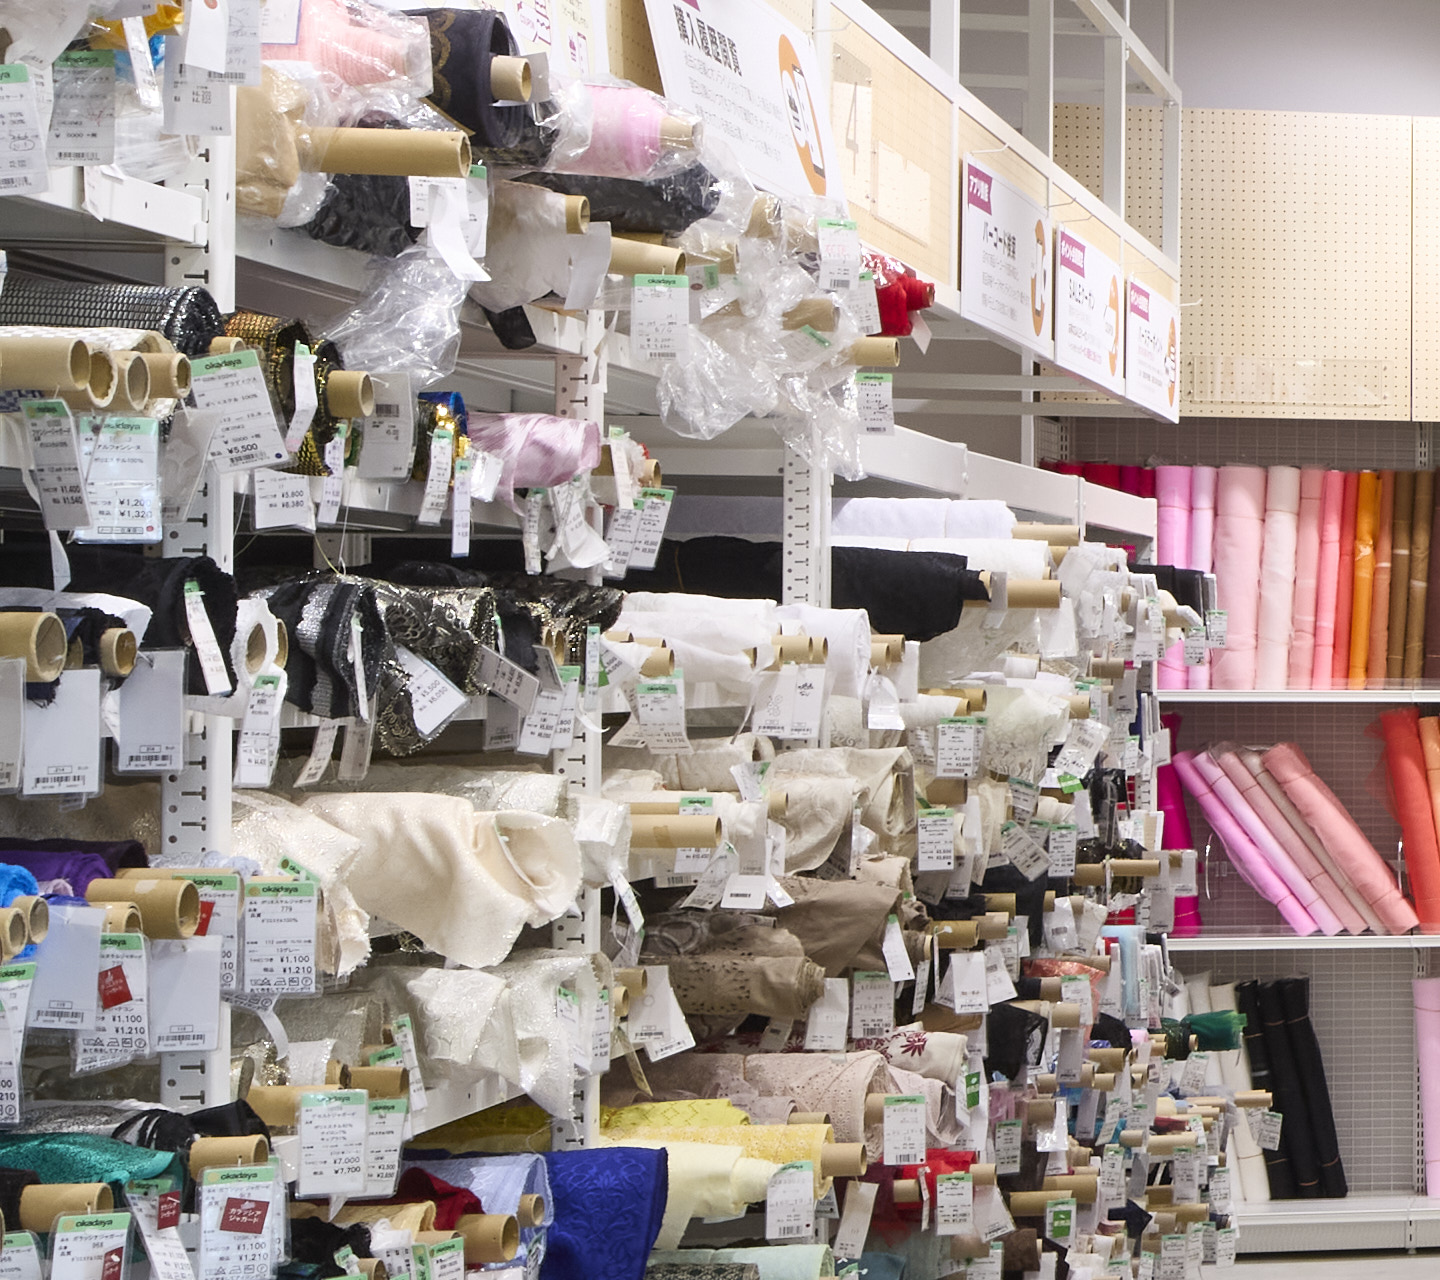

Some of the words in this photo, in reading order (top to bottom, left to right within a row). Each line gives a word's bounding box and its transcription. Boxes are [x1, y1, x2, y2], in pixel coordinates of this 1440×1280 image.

[205, 358, 242, 370] okadaya
[262, 886, 299, 894] okadaya
[221, 1172, 258, 1181] okadaya
[76, 1219, 113, 1228] okadaya
